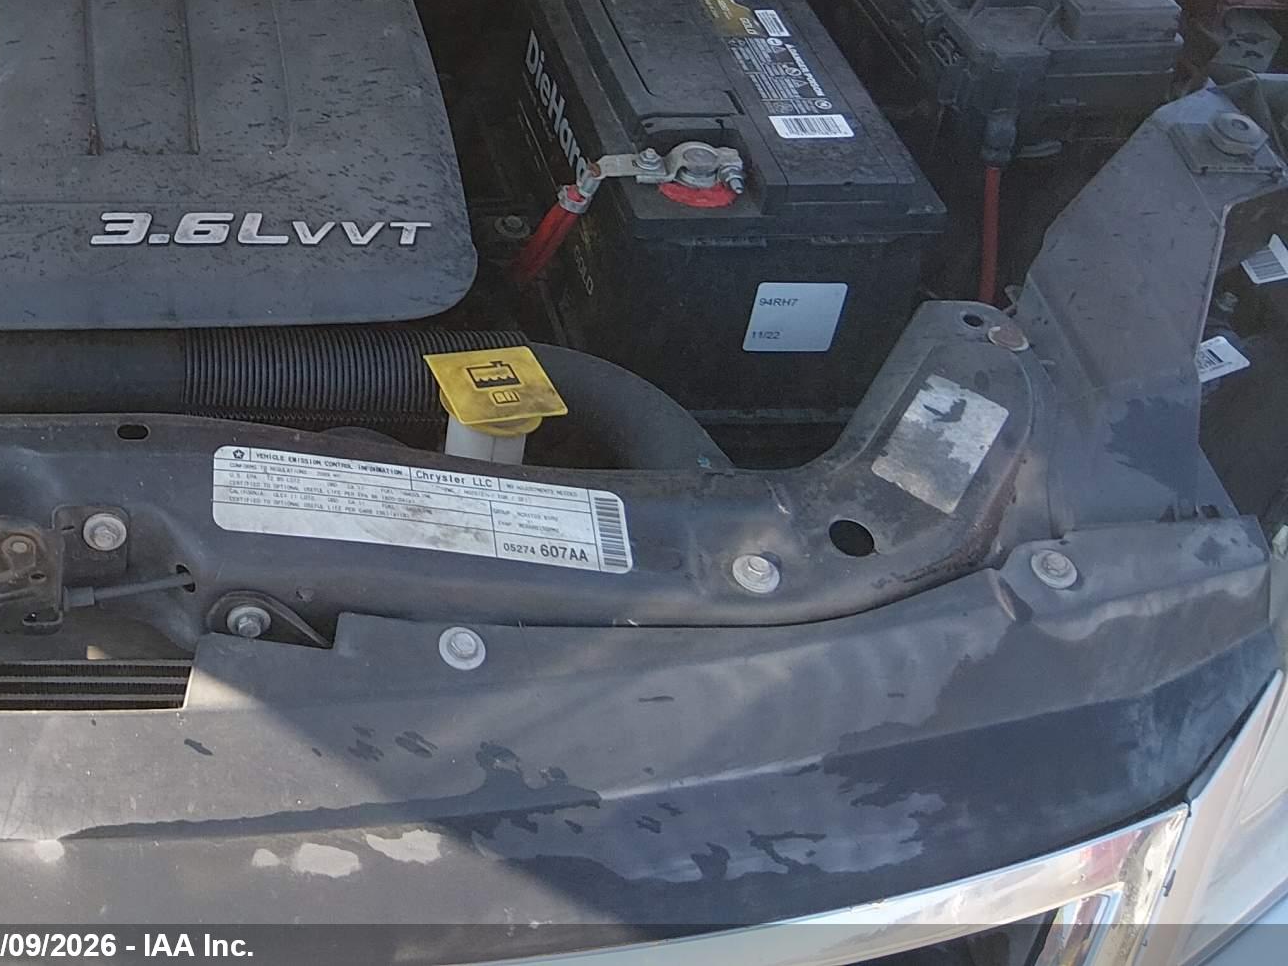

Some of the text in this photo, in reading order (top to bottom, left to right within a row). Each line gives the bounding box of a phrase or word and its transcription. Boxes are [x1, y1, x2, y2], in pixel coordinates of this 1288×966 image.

[751, 330, 782, 340] 11/22
[415, 470, 493, 488] Chrysler LLC
[503, 542, 589, 562] 05274 607AA
